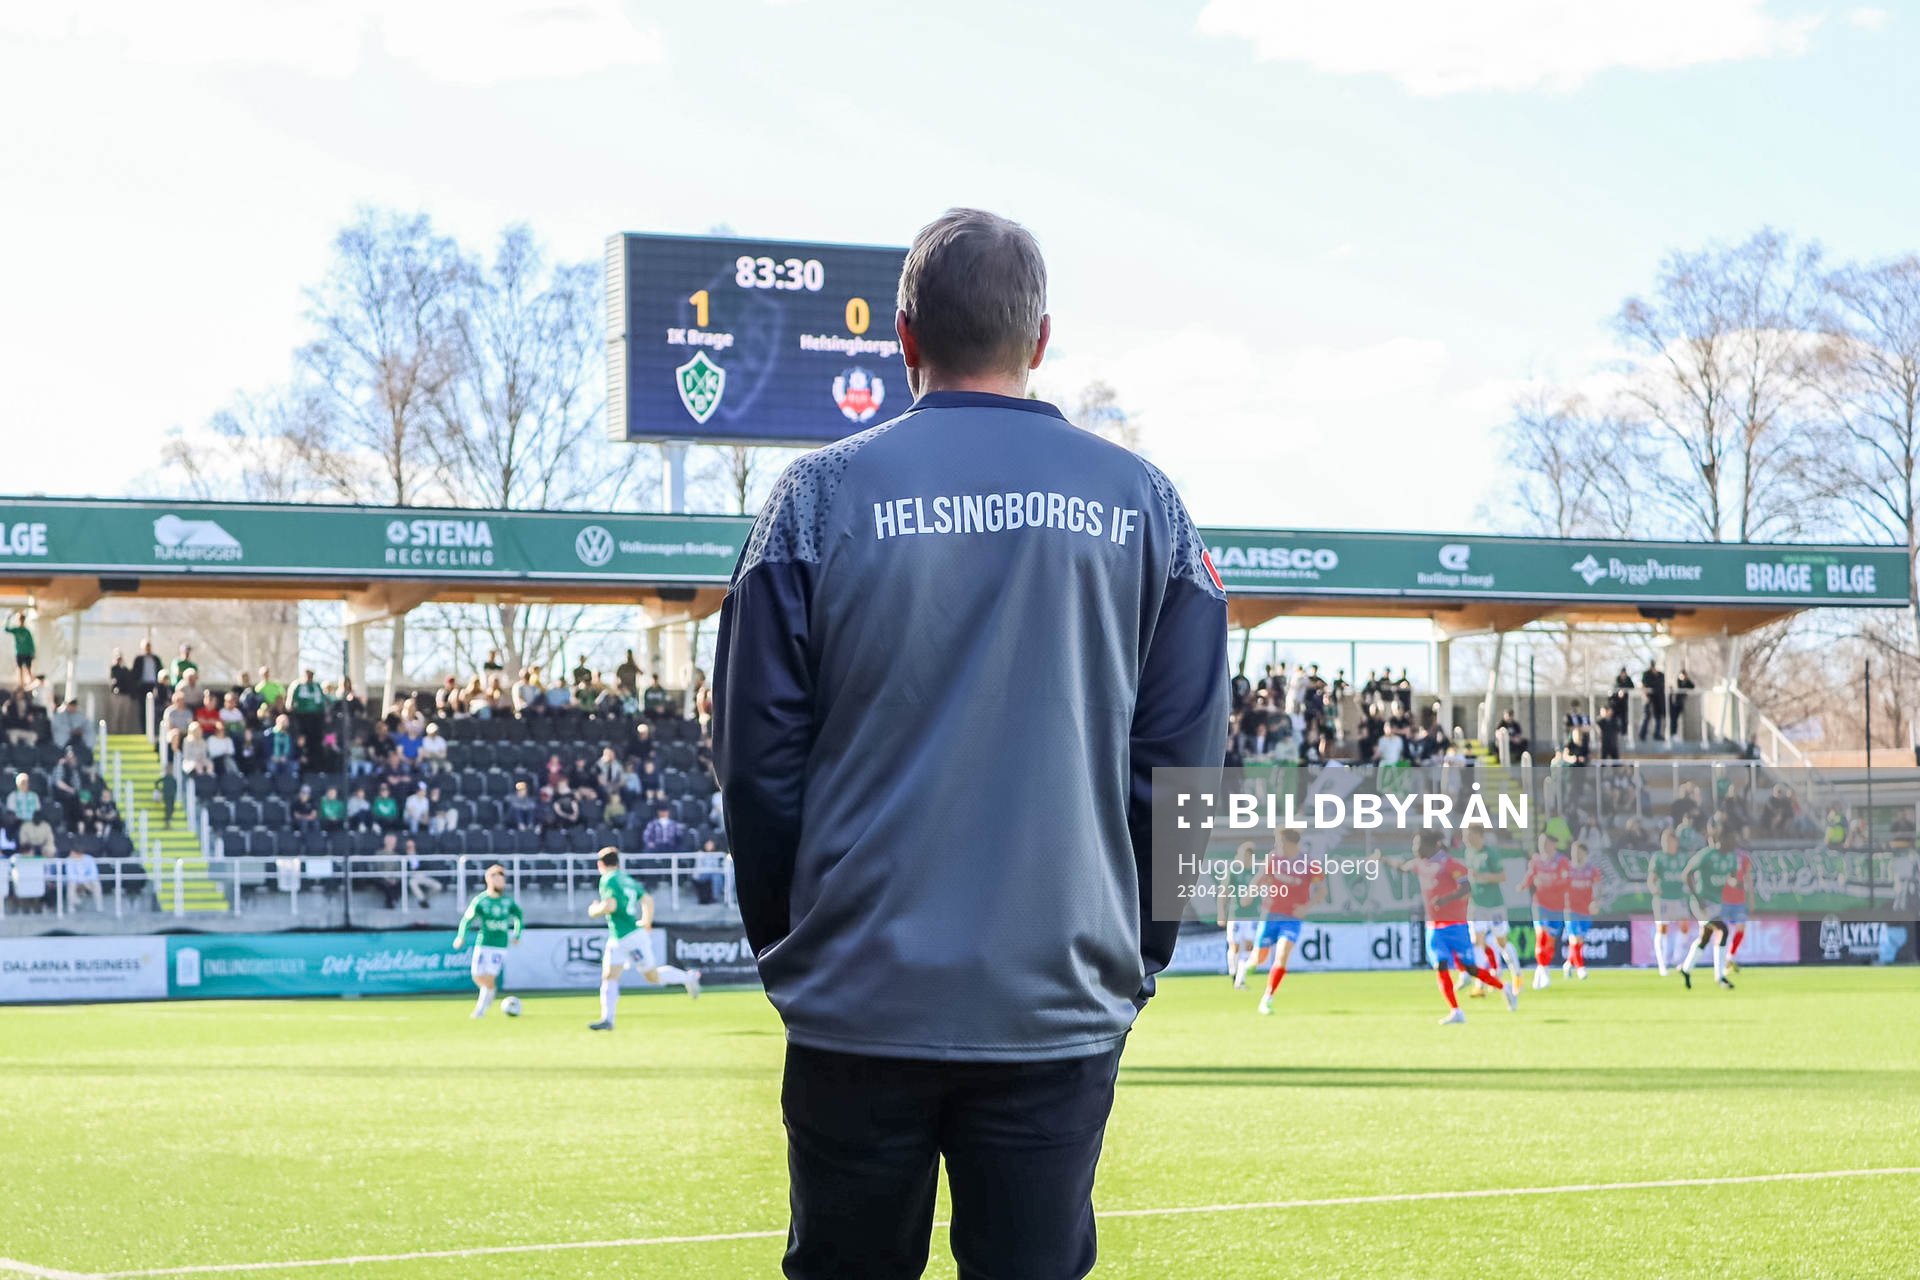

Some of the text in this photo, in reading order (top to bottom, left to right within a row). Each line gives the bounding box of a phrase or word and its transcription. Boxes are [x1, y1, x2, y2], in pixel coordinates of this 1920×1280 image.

[735, 255, 825, 291] 83:30
[689, 290, 709, 328] 1
[845, 297, 870, 335] 0
[667, 328, 734, 350] IK Brage
[800, 334, 898, 358] Helsingborgs
[873, 491, 1138, 546] HELSINGBORGS IF
[409, 520, 494, 547] STENA
[385, 547, 494, 566] RECYCLING
[1745, 562, 1877, 593] BRAGE BLGE
[568, 936, 604, 961] HS
[676, 939, 740, 963] happy
